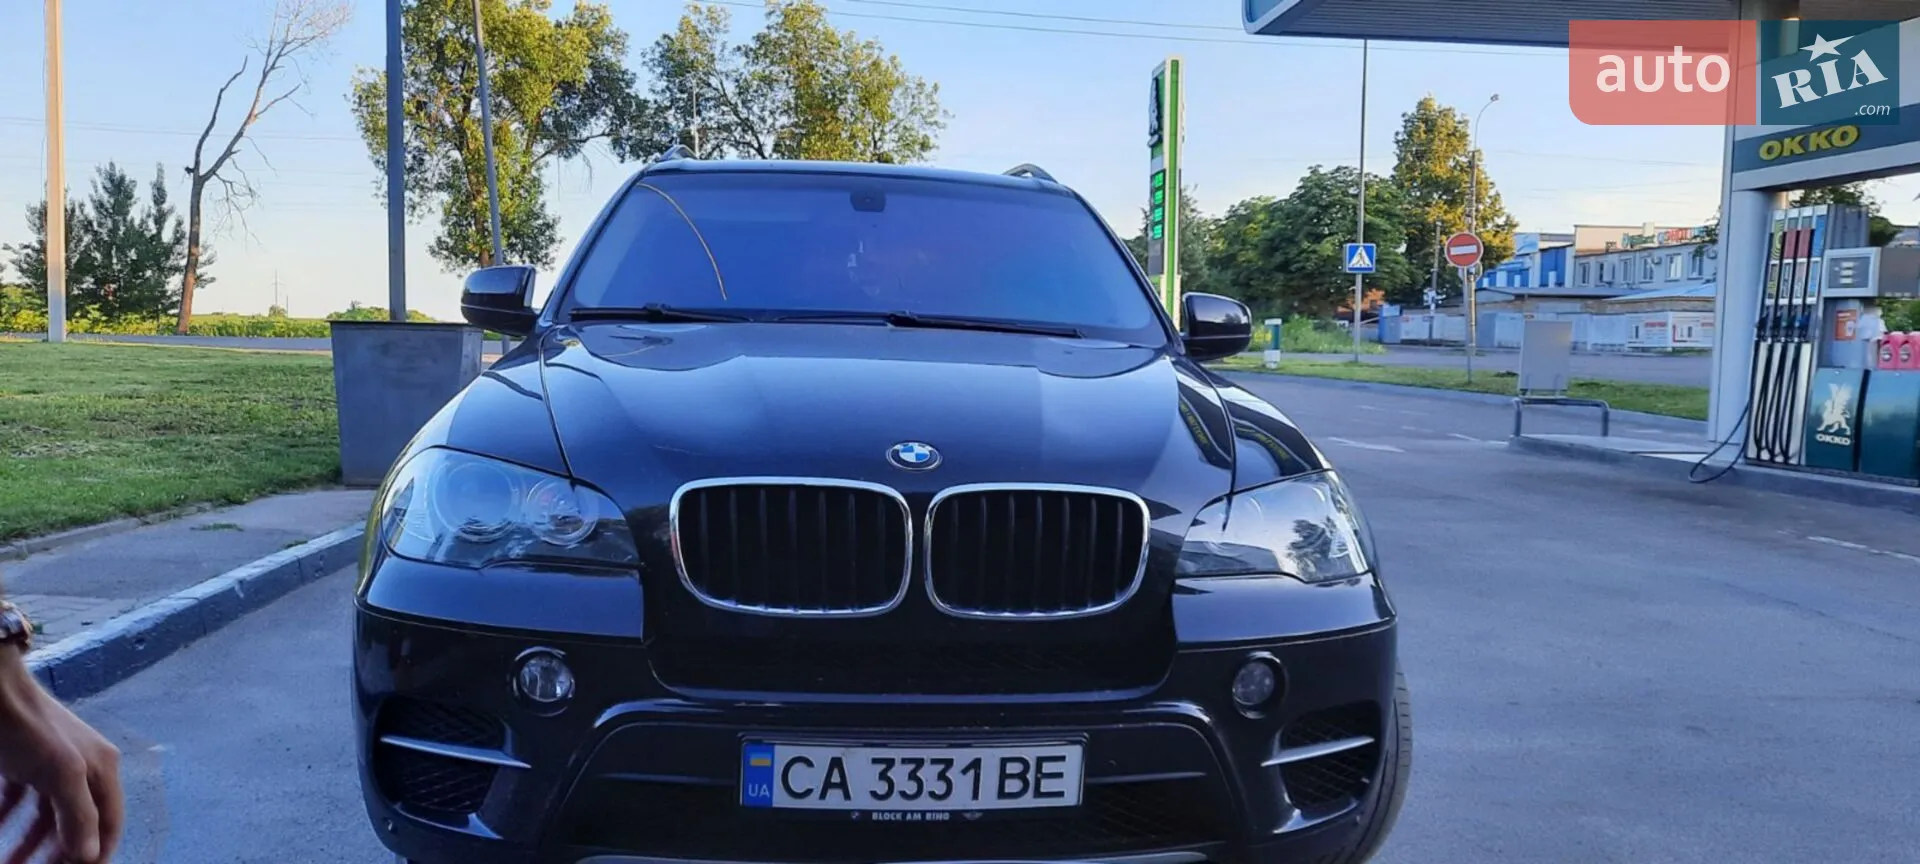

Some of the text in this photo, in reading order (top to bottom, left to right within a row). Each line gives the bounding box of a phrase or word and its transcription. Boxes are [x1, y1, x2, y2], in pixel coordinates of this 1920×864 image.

[1759, 125, 1858, 161] OKKO
[748, 783, 770, 798] UA
[780, 755, 1067, 801] CA 3331 BE
[905, 812, 922, 821] AM
